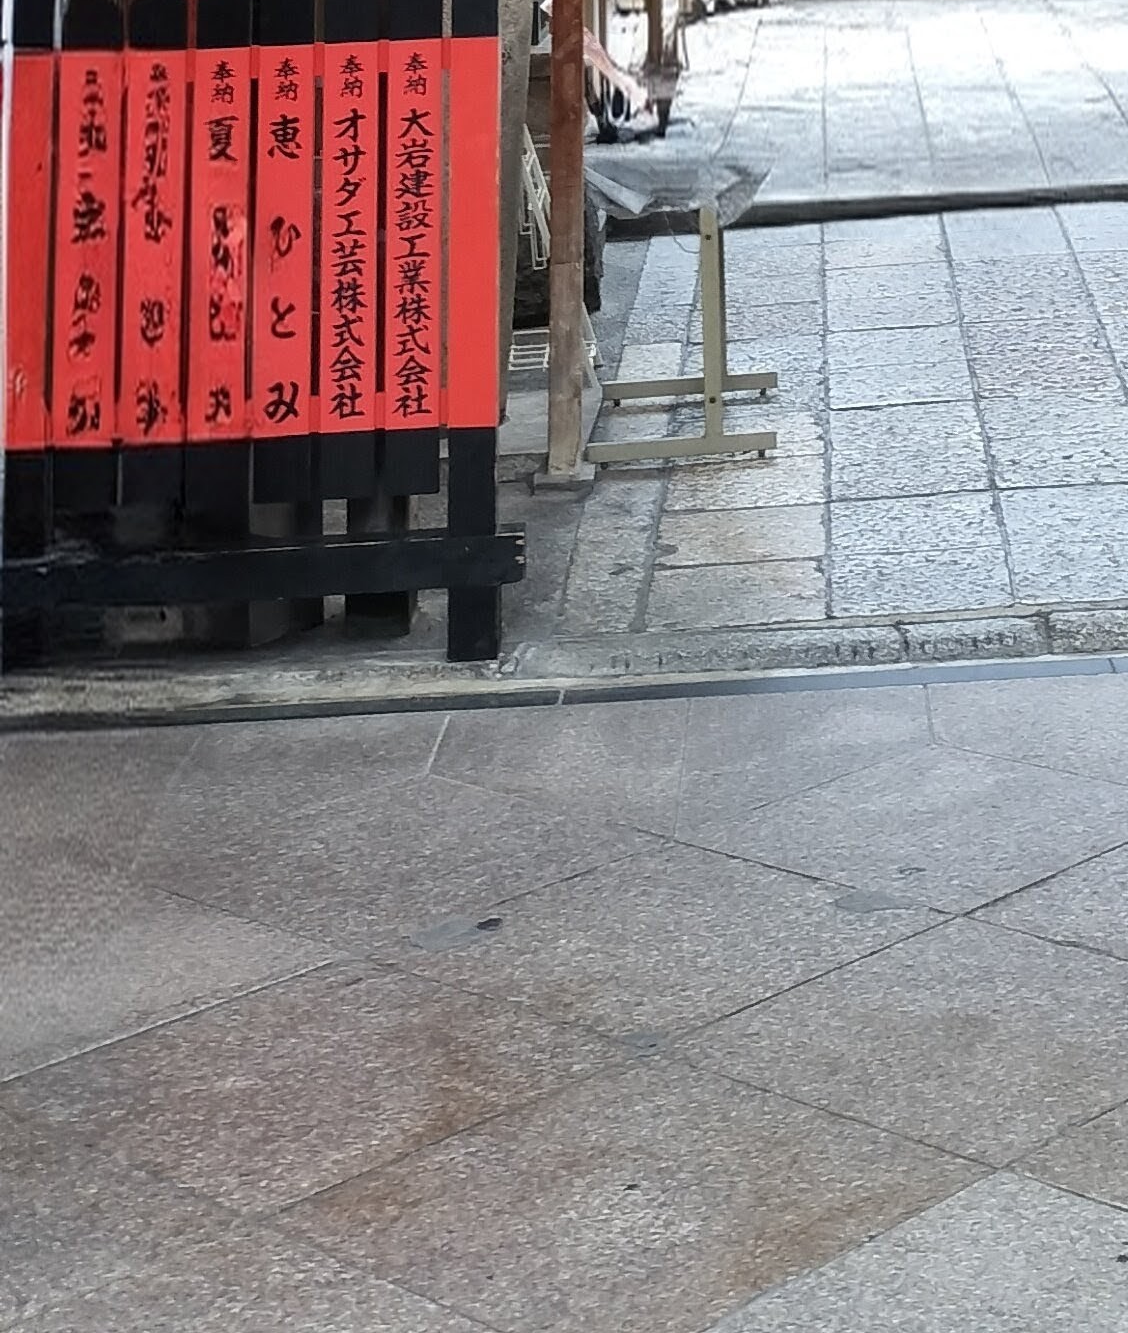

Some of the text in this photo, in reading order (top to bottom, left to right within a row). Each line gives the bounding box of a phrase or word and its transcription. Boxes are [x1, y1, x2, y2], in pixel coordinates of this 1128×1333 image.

[210, 60, 236, 104] 奉納
[274, 57, 301, 102] 奉納
[338, 54, 365, 99] 奉納
[403, 52, 429, 95] 奉納
[329, 108, 368, 420] オサダ工芸株式会社
[394, 108, 435, 418] 大岩建設工業株式会社
